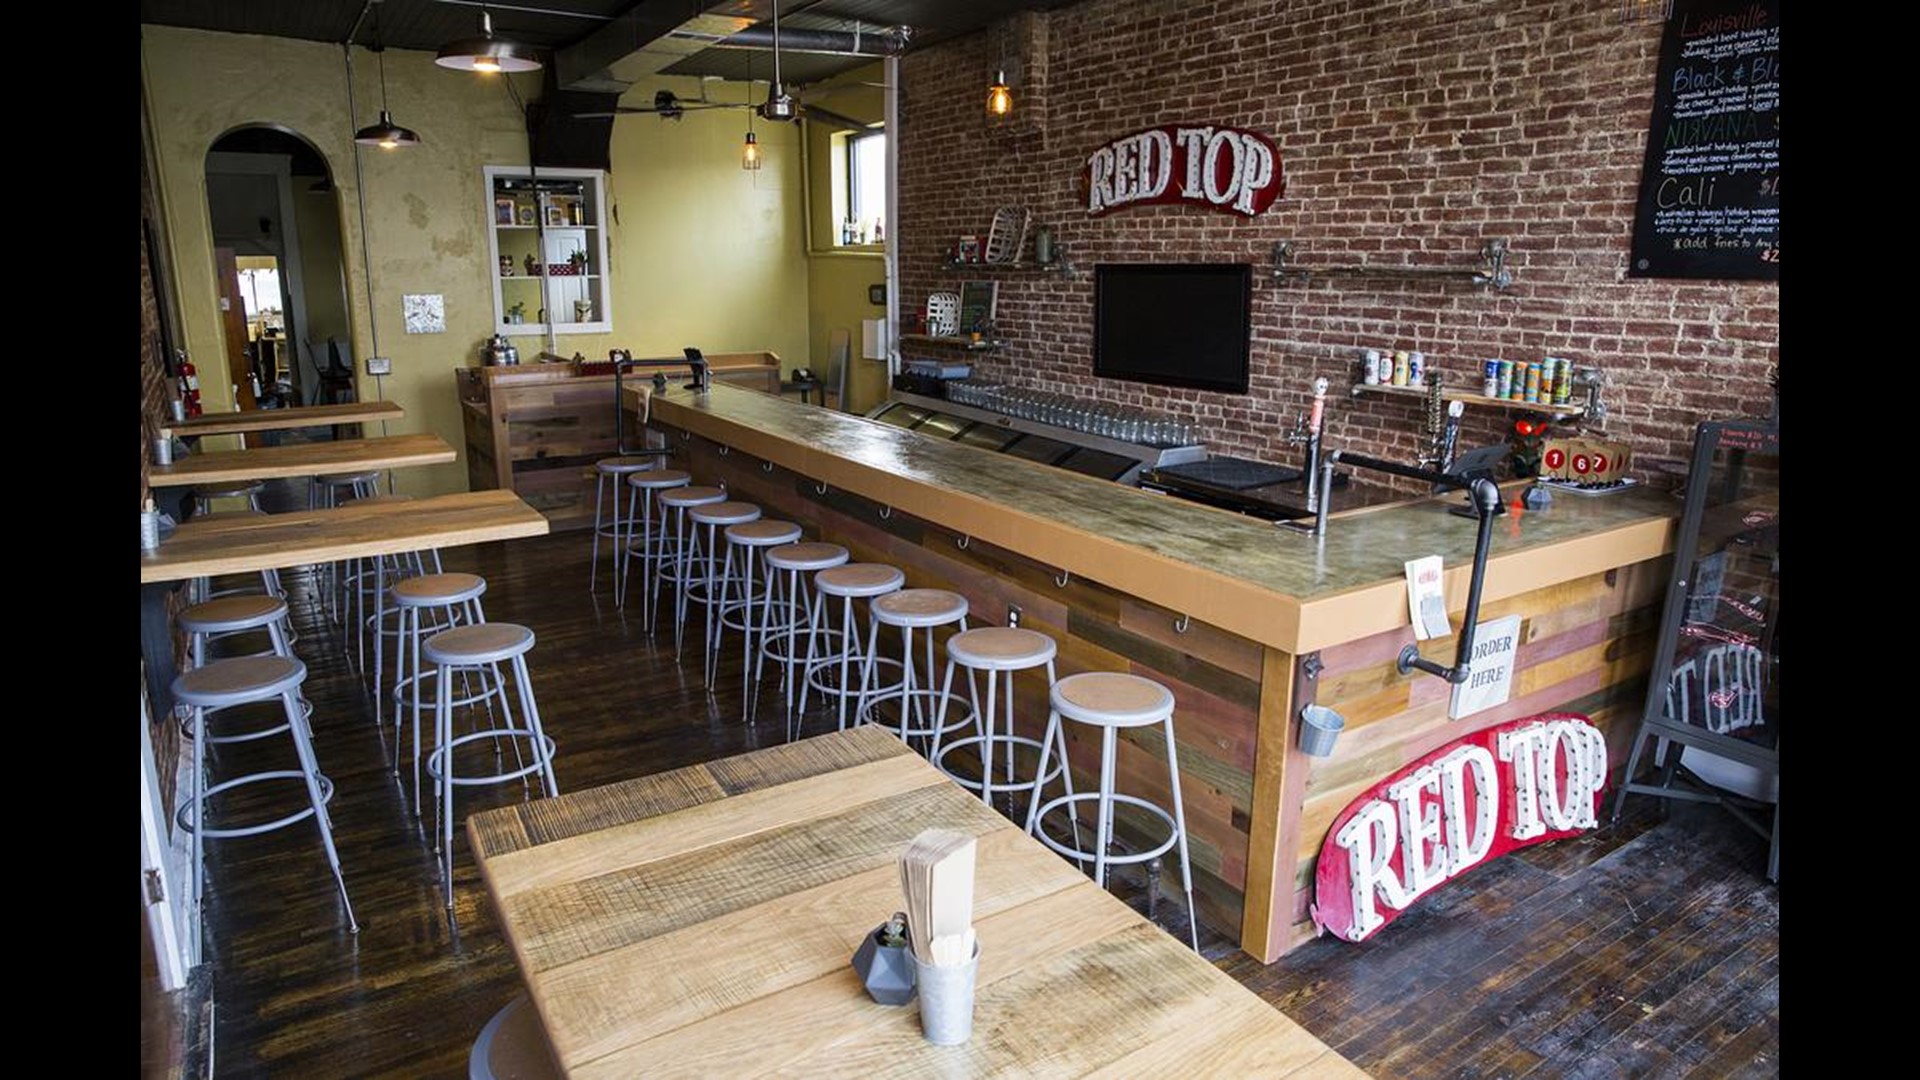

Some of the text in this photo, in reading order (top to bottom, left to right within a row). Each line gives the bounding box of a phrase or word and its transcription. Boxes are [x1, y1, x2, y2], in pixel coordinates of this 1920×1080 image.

[1681, 4, 1767, 37] Louisville
[1673, 66, 1725, 93] Black
[1088, 126, 1273, 215] RED TOP
[1657, 177, 1716, 208] Cali
[1714, 236, 1739, 248] fries
[1552, 453, 1559, 465] 1
[1577, 458, 1586, 470] 6
[1593, 456, 1603, 468] 7
[1470, 665, 1505, 689] HERE
[1336, 718, 1608, 942] RED TOP
